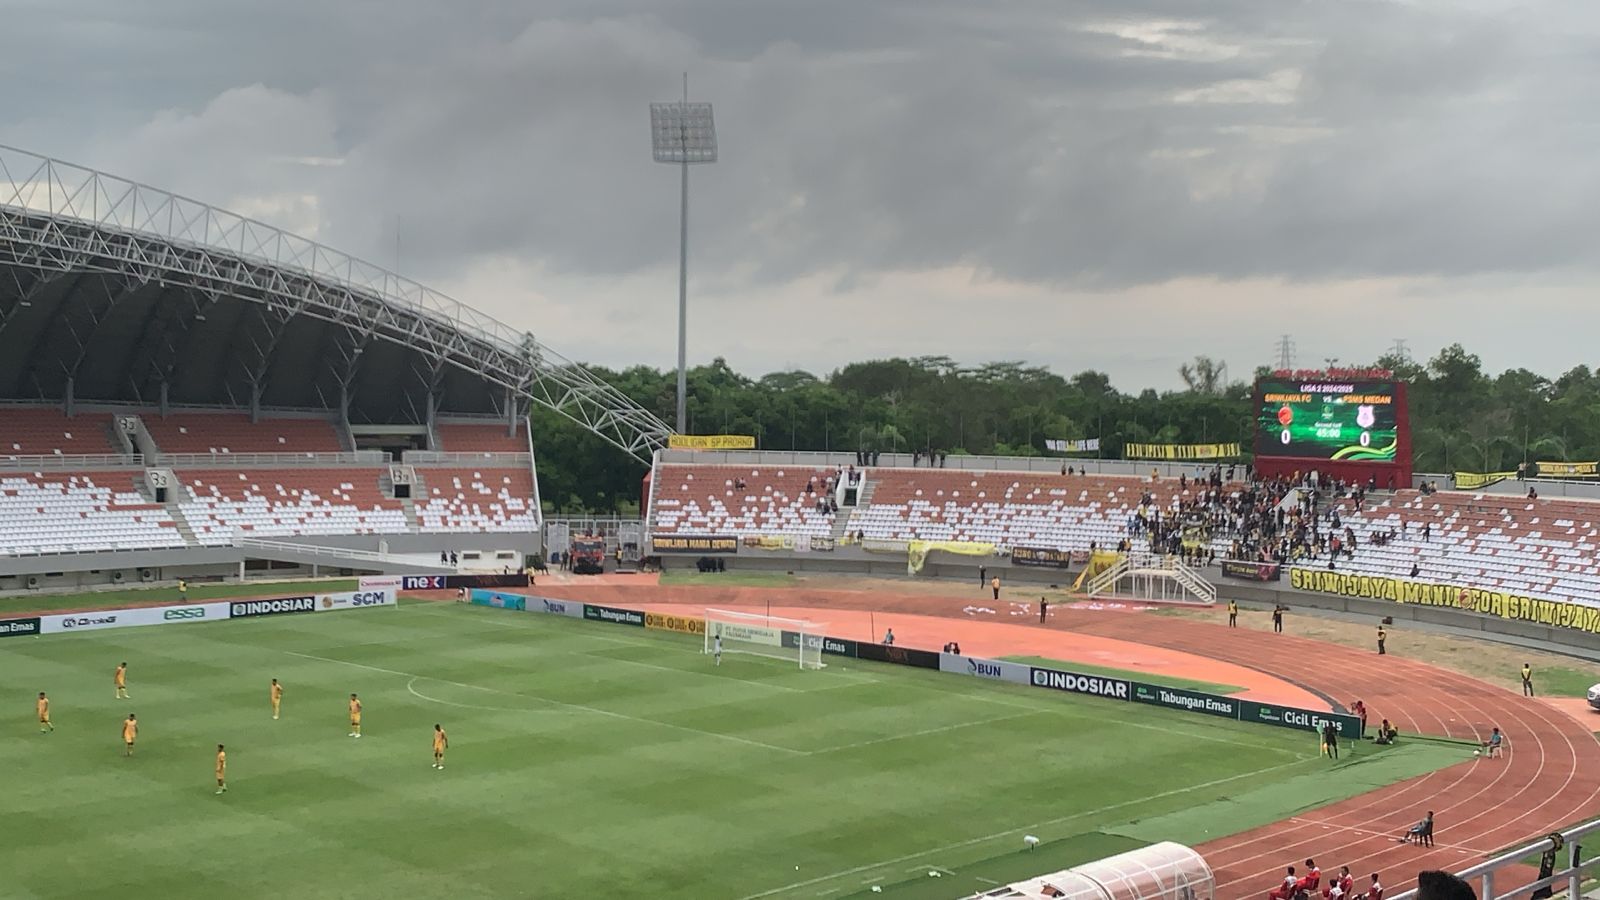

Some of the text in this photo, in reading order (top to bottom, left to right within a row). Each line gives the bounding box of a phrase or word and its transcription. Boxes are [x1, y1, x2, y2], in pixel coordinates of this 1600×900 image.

[1300, 384, 1316, 393] LIGA
[1316, 385, 1322, 393] 2
[1264, 393, 1301, 403] SRIWIJAYA
[1301, 393, 1313, 403] FC
[1343, 394, 1364, 404] PSMS
[1364, 395, 1392, 404] MEDAN
[1280, 429, 1291, 445] 0
[1315, 428, 1341, 439] 45:00
[1360, 431, 1371, 447] 0
[408, 576, 441, 588] nex
[247, 598, 313, 614] INDOSIAR
[352, 592, 385, 606] SCM
[1290, 568, 1398, 602] SRIWIJAYA
[1470, 588, 1502, 616] FOR
[1509, 595, 1600, 633] SRIWIJAY
[164, 607, 205, 620] essa
[600, 609, 625, 622] Tabungan
[626, 613, 642, 623] Emas
[11, 622, 34, 631] Emas
[826, 640, 846, 652] Emas
[977, 663, 1000, 676] BUN
[1050, 672, 1127, 698] INDOSIAR
[1160, 690, 1232, 713] Tabungan Emas
[1284, 711, 1309, 726] Cicil
